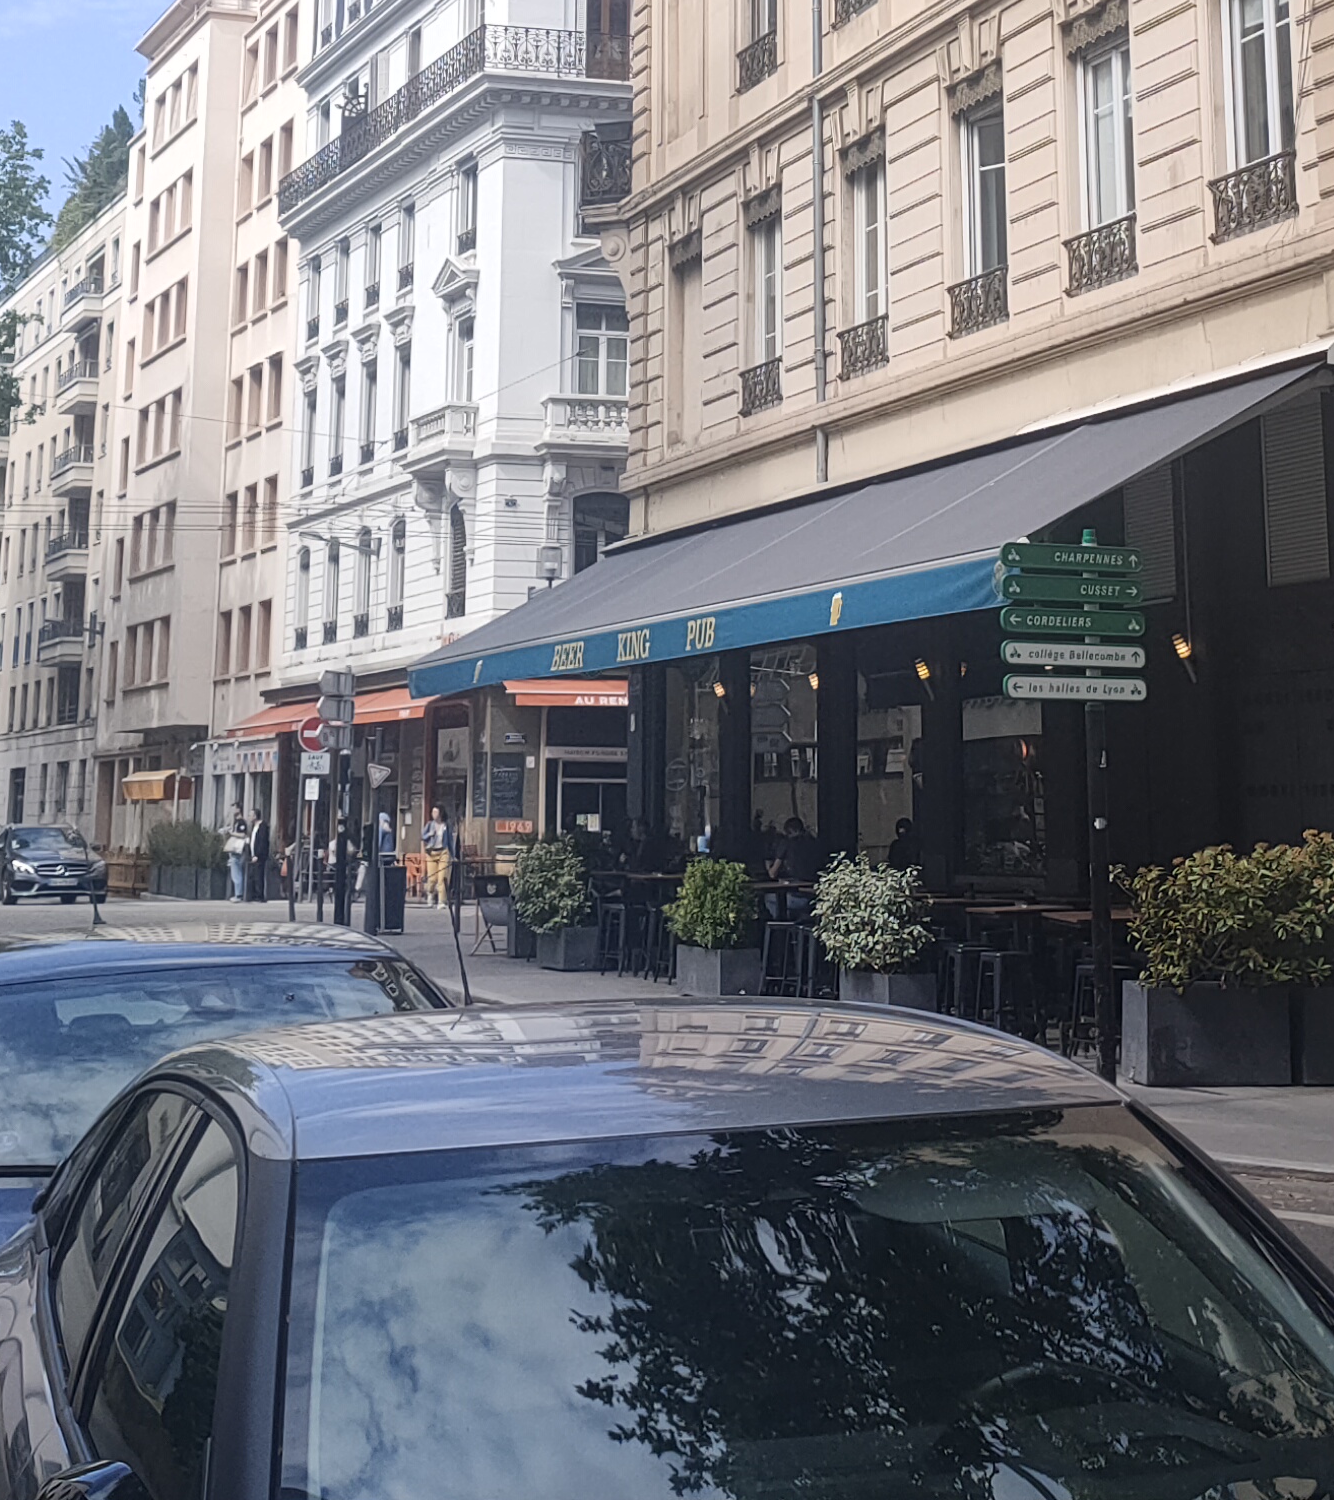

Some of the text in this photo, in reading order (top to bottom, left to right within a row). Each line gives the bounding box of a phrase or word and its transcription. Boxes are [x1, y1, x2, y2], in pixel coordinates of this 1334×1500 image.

[1054, 551, 1124, 565] CHARPENNES
[1080, 584, 1120, 596] CUSSET
[1026, 615, 1092, 628] CORDELIERS
[550, 616, 716, 672] BEER KING PUB
[1028, 649, 1126, 661] collège Bellecombe
[1028, 682, 1125, 696] les halles de Lyon
[574, 695, 595, 705] AU
[507, 820, 532, 833] 1969
